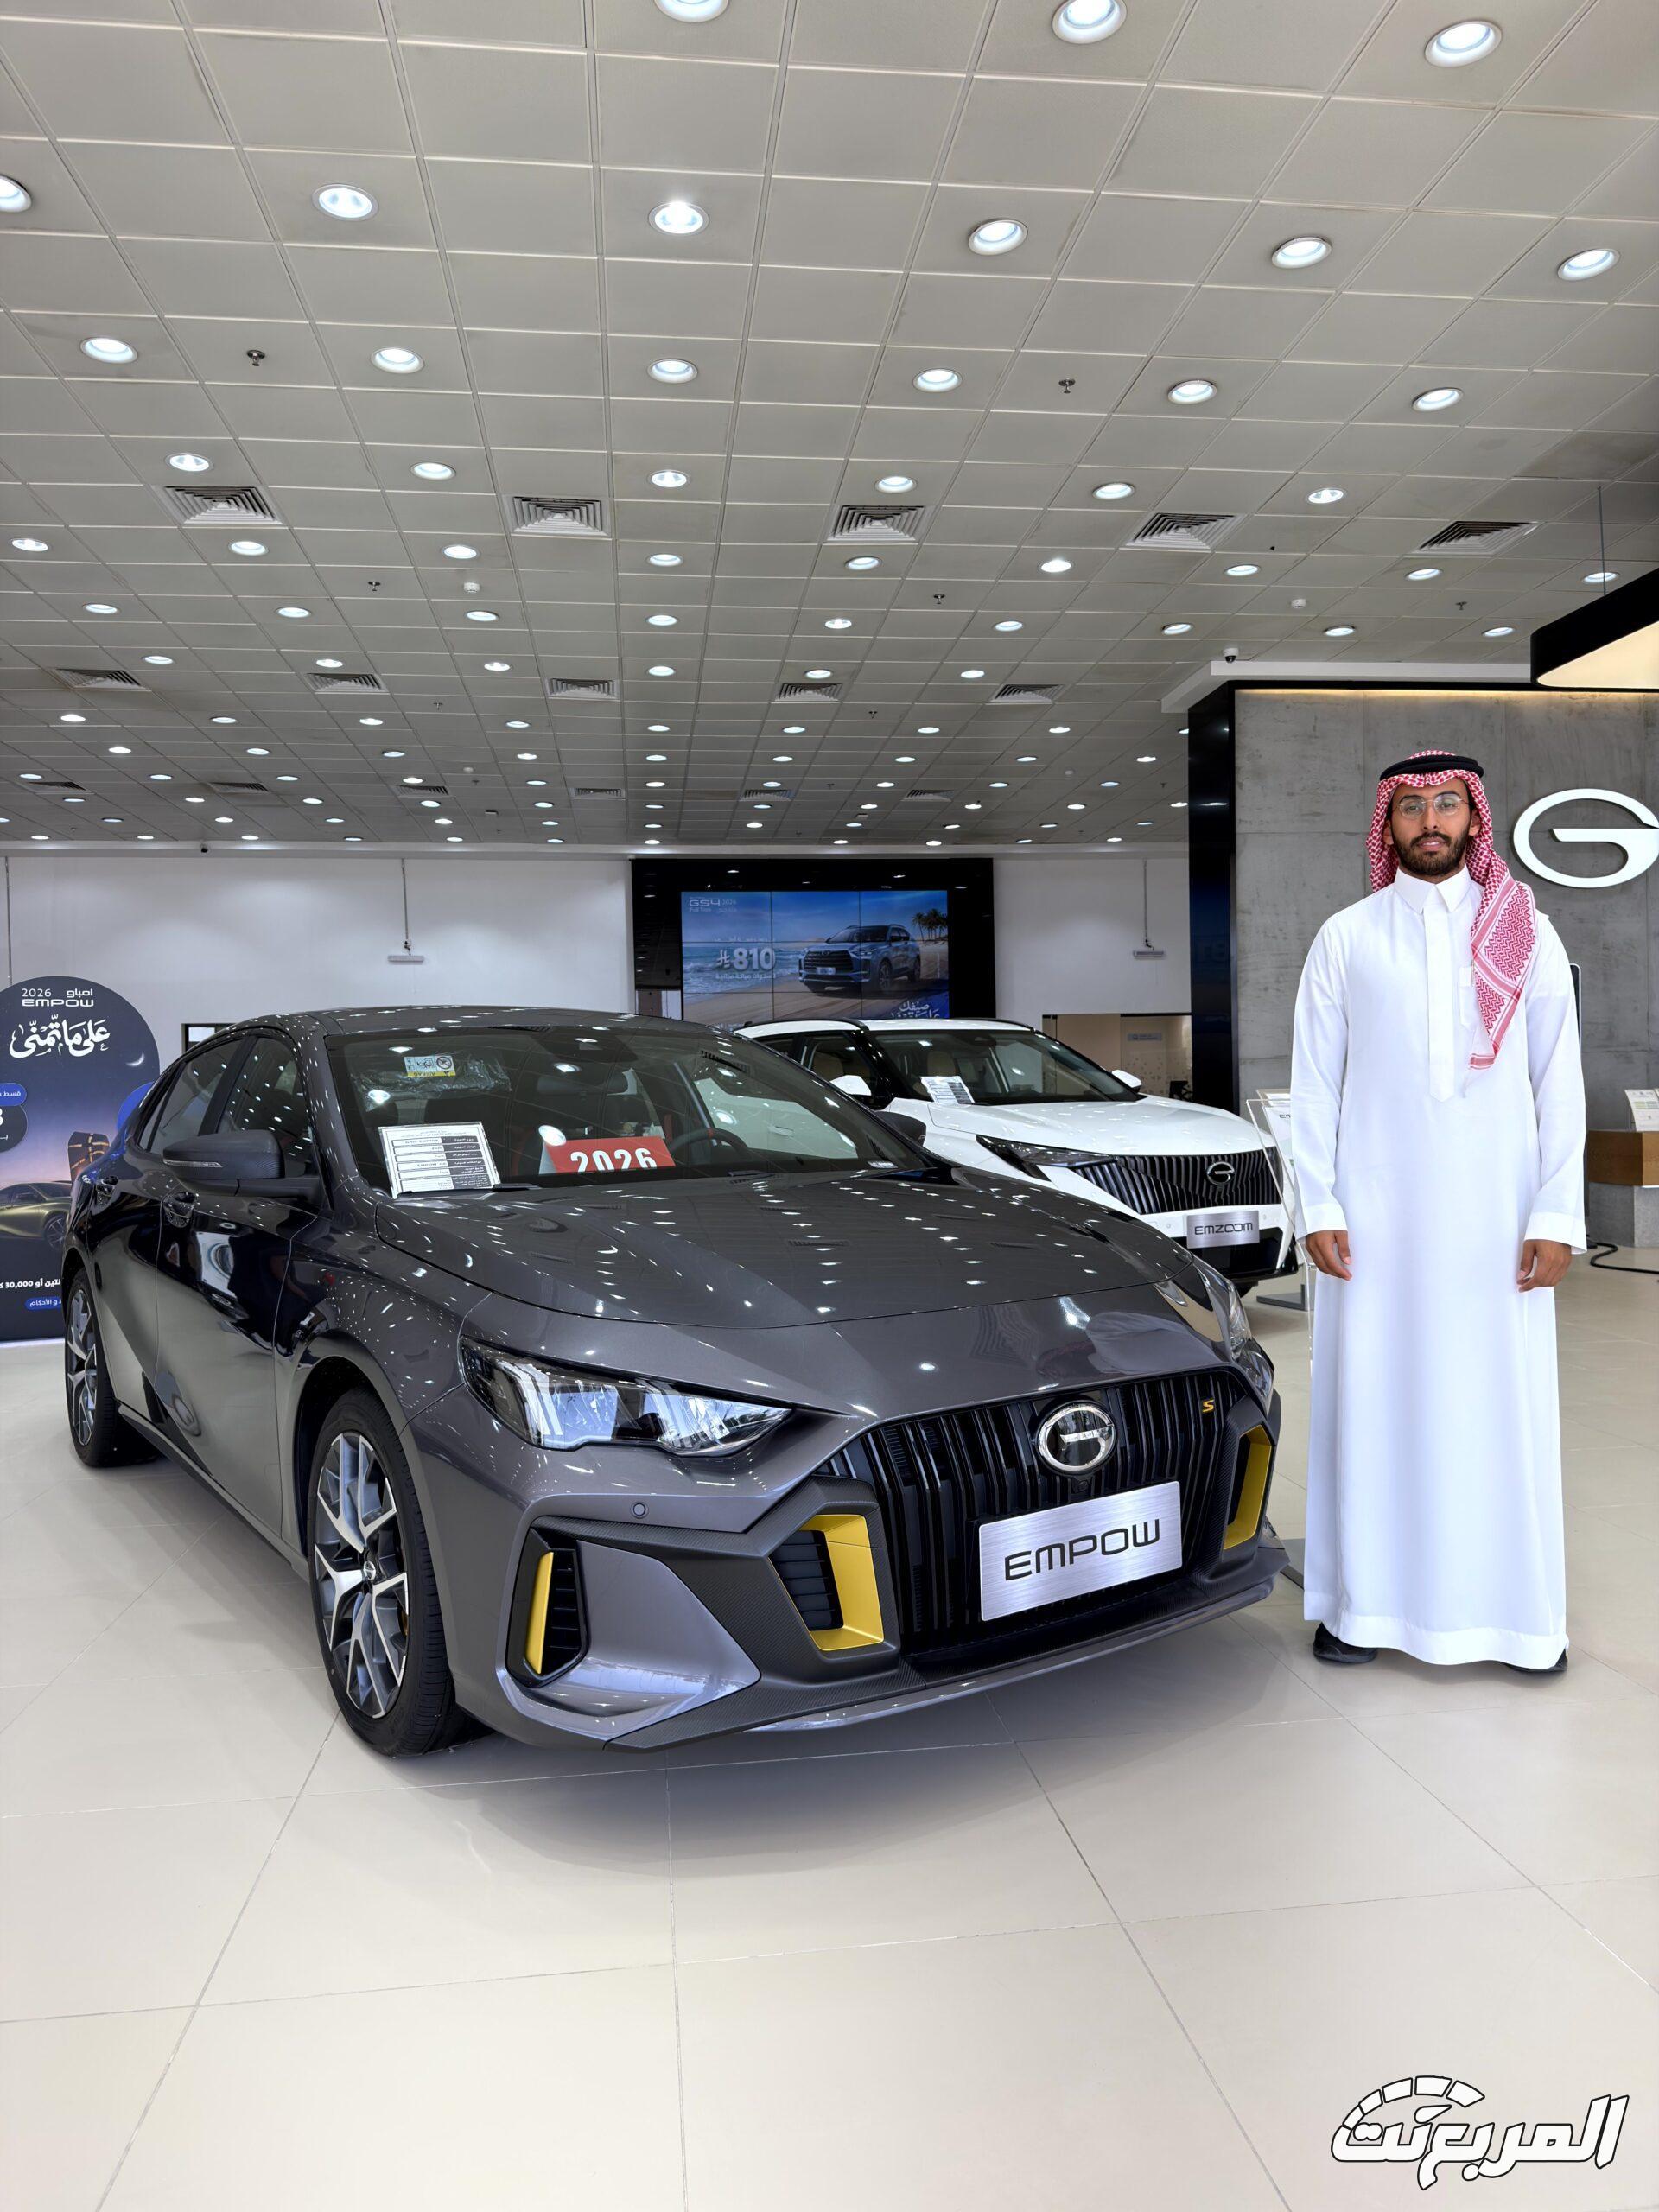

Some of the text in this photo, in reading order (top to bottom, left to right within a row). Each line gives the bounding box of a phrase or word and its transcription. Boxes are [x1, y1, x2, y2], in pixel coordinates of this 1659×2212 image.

[733, 948, 775, 970] 810
[22, 988, 52, 997] 2026
[22, 999, 94, 1007] EMPOW
[570, 1147, 658, 1173] 2026
[1194, 1222, 1253, 1236] EMZOOM
[5, 1281, 34, 1289] 30,000
[1201, 1398, 1215, 1414] S
[1004, 1518, 1160, 1582] EMPOW
